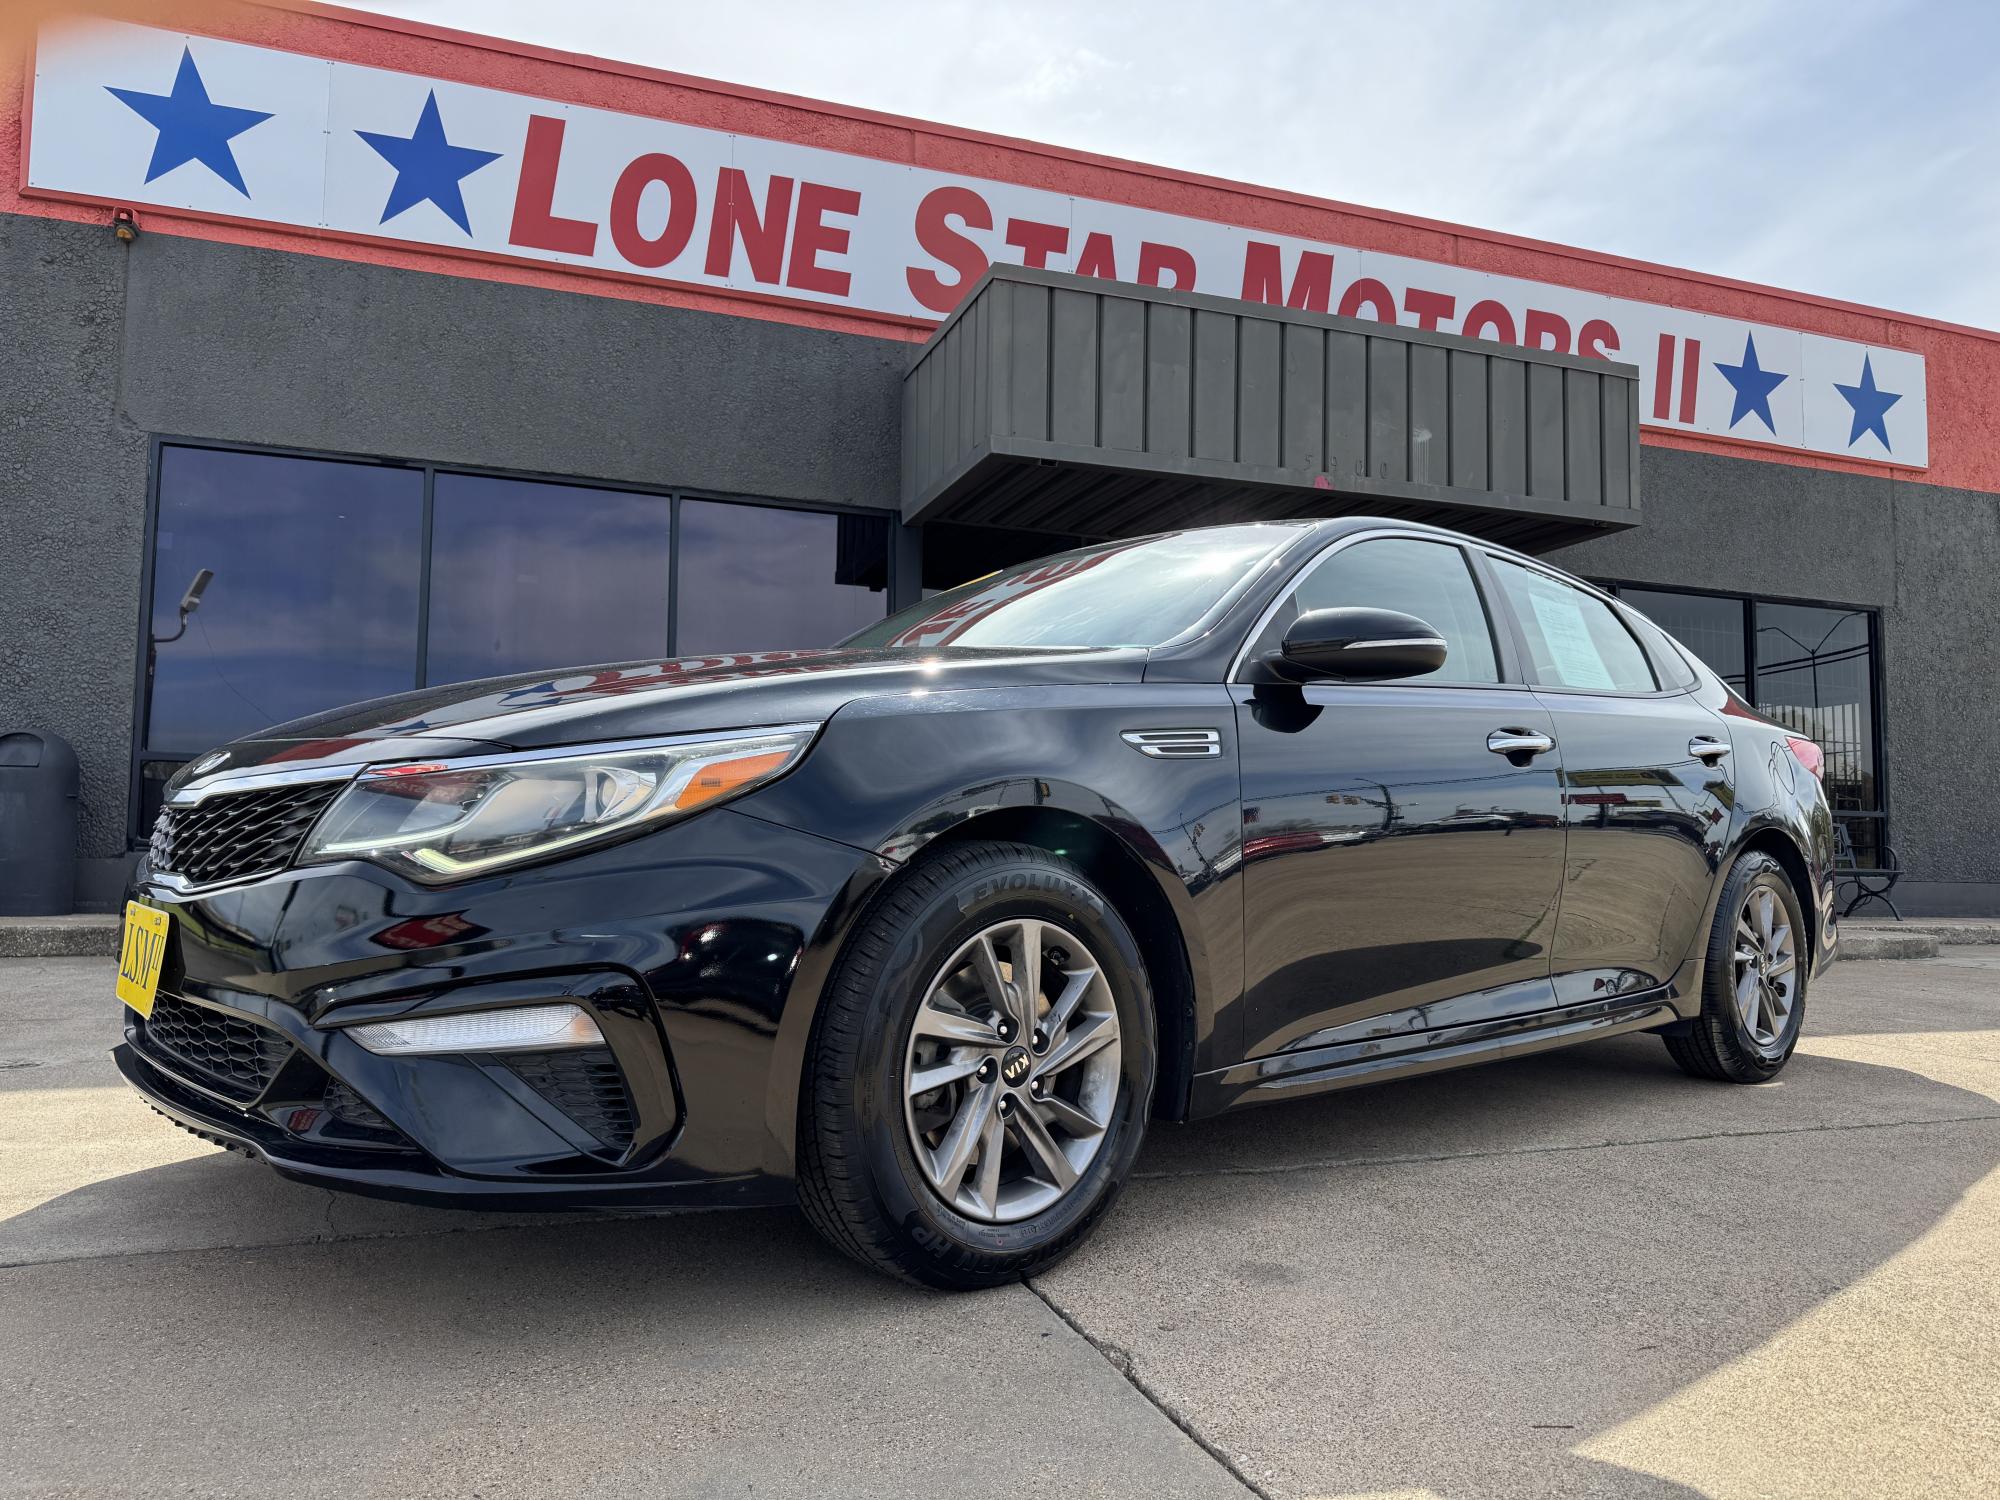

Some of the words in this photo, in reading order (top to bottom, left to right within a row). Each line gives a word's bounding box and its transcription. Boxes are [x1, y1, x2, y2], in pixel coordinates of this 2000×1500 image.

[508, 114, 862, 298] LONE
[1653, 333, 1701, 425] II
[1005, 1054, 1030, 1079] KIA
